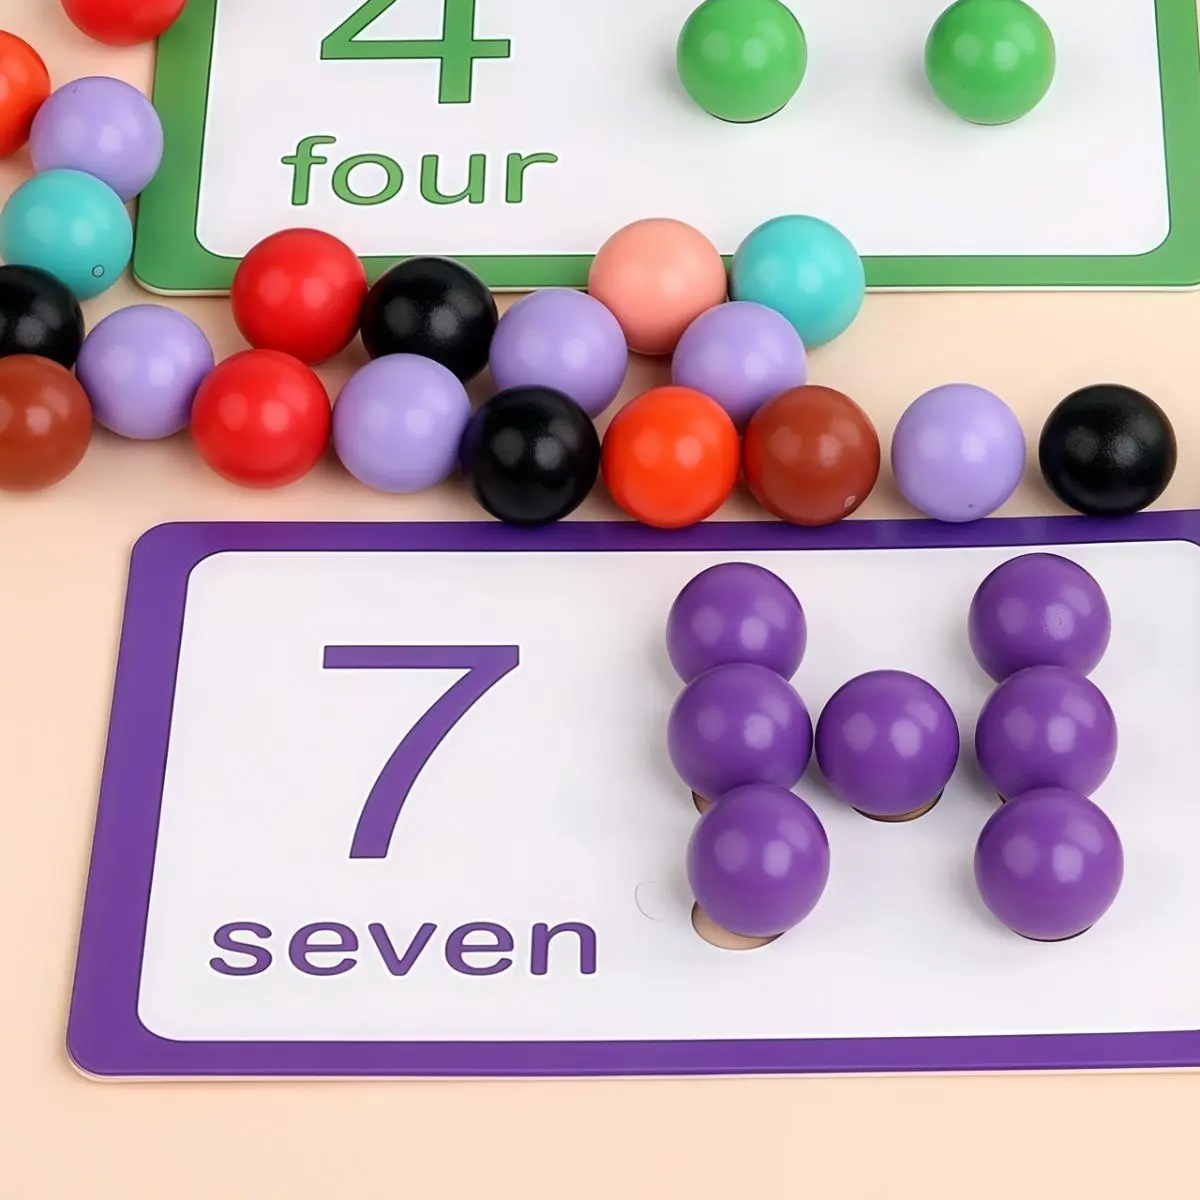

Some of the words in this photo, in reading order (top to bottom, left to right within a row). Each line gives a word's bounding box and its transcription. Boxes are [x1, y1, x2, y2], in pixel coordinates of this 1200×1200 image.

[281, 135, 558, 206] four
[322, 645, 520, 859] 7
[209, 922, 597, 977] seven
